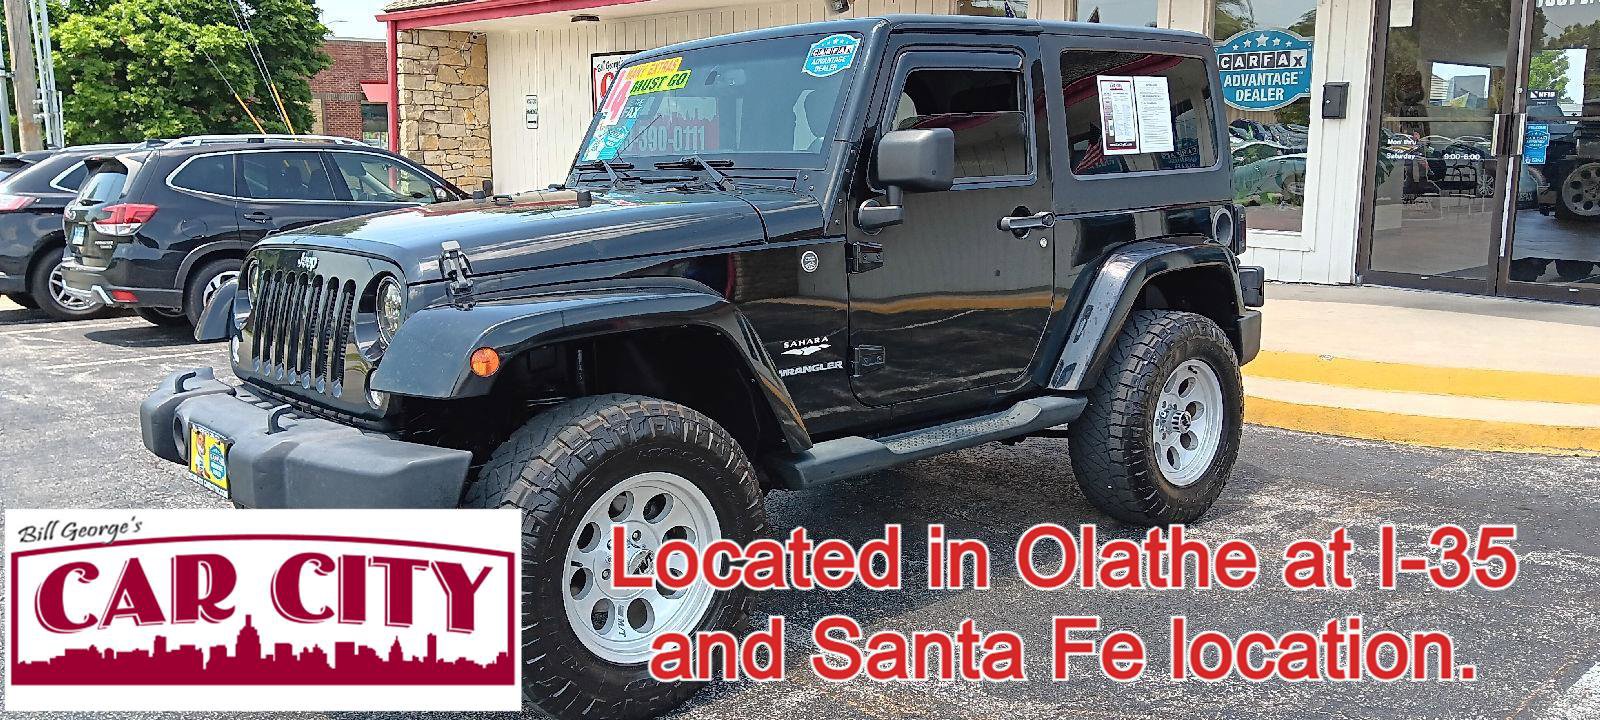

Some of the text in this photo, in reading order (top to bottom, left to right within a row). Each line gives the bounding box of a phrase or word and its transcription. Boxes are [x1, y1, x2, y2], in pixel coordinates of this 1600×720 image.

[1220, 53, 1304, 69] CARFAX
[631, 76, 667, 93] MUST
[667, 73, 688, 87] GO
[1224, 71, 1298, 88] ADVANTAGE
[1235, 88, 1285, 101] DEALER
[783, 336, 829, 349] SAHARA
[778, 361, 843, 377] WRANGLER
